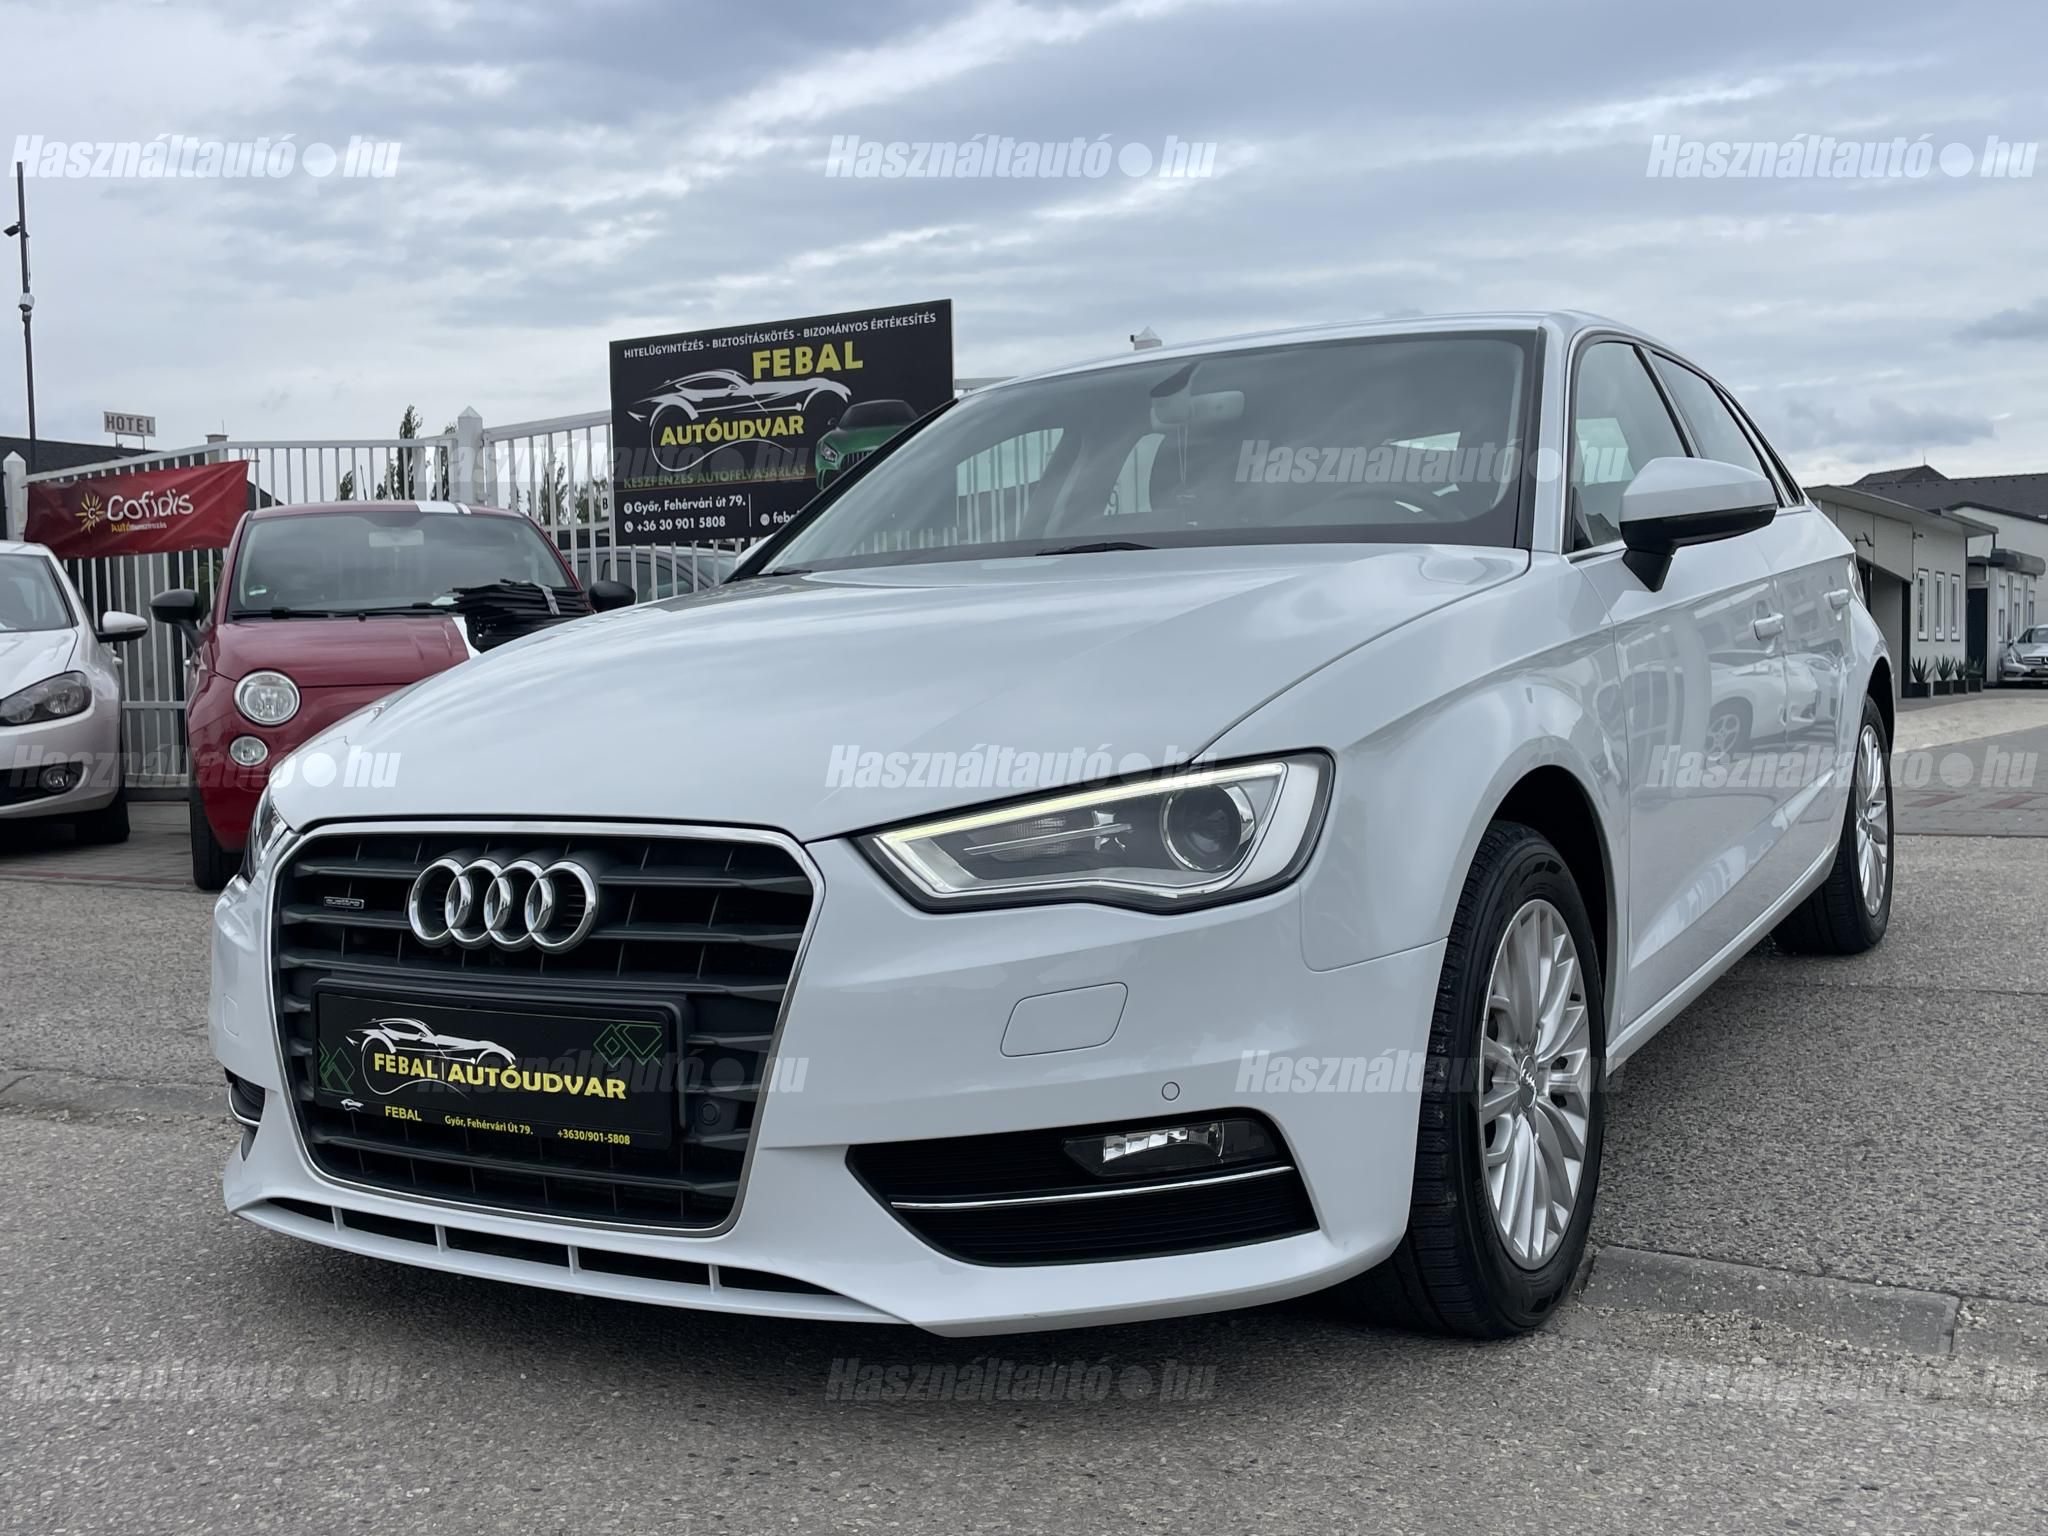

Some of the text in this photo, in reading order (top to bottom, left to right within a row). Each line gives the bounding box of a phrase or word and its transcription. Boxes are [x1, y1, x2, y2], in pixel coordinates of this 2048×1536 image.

[624, 339, 704, 359] HITELÜGYINTÉZÉS
[712, 328, 795, 349] BIZTOSÍTÁSKÖTÉS
[803, 321, 869, 338] BIZOMÁNYOS
[870, 311, 937, 331] ÉRTÉKESÍTÉS
[752, 341, 864, 380] FEBAL
[106, 415, 154, 434] HOTEL
[659, 415, 805, 447] AUTÓUDVAR
[107, 488, 194, 521] Cofidis
[634, 494, 747, 515] Győr, Fehérvári út 79.
[637, 516, 726, 532] +36 30 901 5808
[374, 1052, 627, 1100] FEBAL AUTÓUDVAR
[384, 1105, 422, 1121] FEBAL
[444, 1115, 466, 1128] Győr,
[467, 1117, 507, 1133] Fehérvári
[519, 1124, 534, 1135] 79.
[557, 1128, 631, 1145] +3630/901-5808
